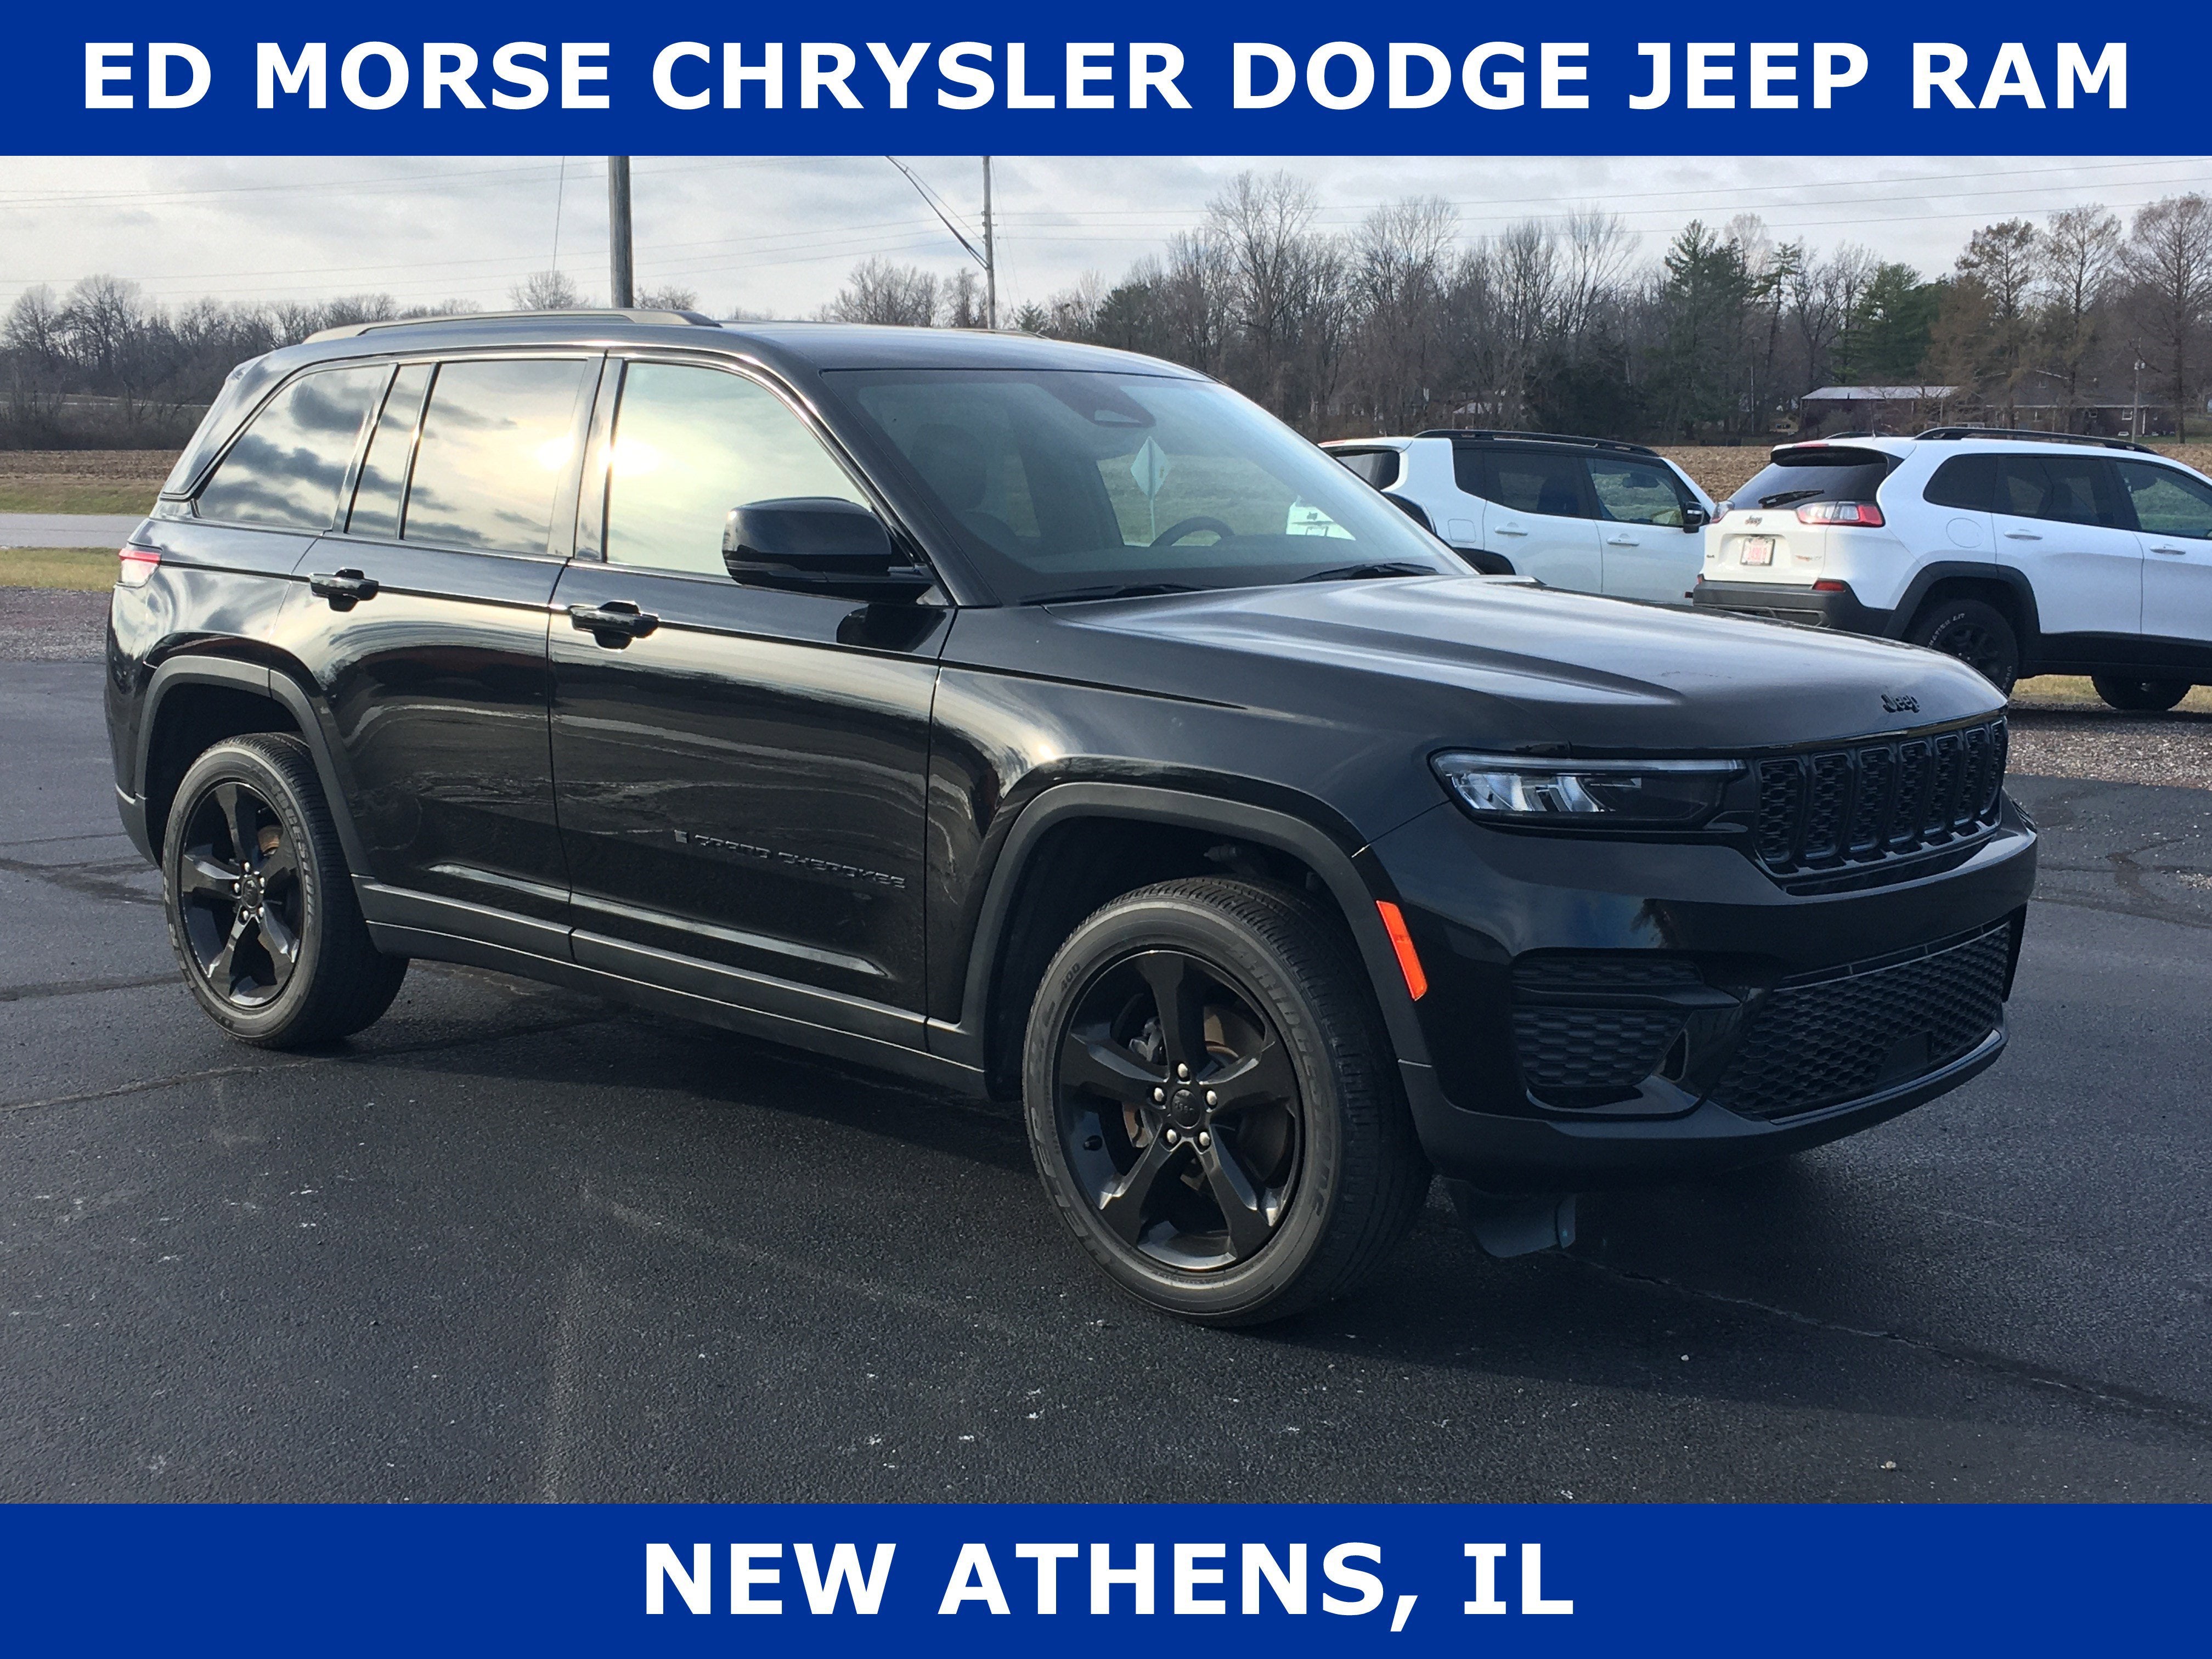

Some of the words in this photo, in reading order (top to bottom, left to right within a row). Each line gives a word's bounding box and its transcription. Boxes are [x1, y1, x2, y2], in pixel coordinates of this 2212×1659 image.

[1881, 693, 1921, 714] Jeep
[777, 851, 907, 889] CHEROKEE
[1060, 962, 1082, 994] 400
[1227, 942, 1336, 1217] BRIDGESTONE
[1030, 1107, 1131, 1281] UELER
